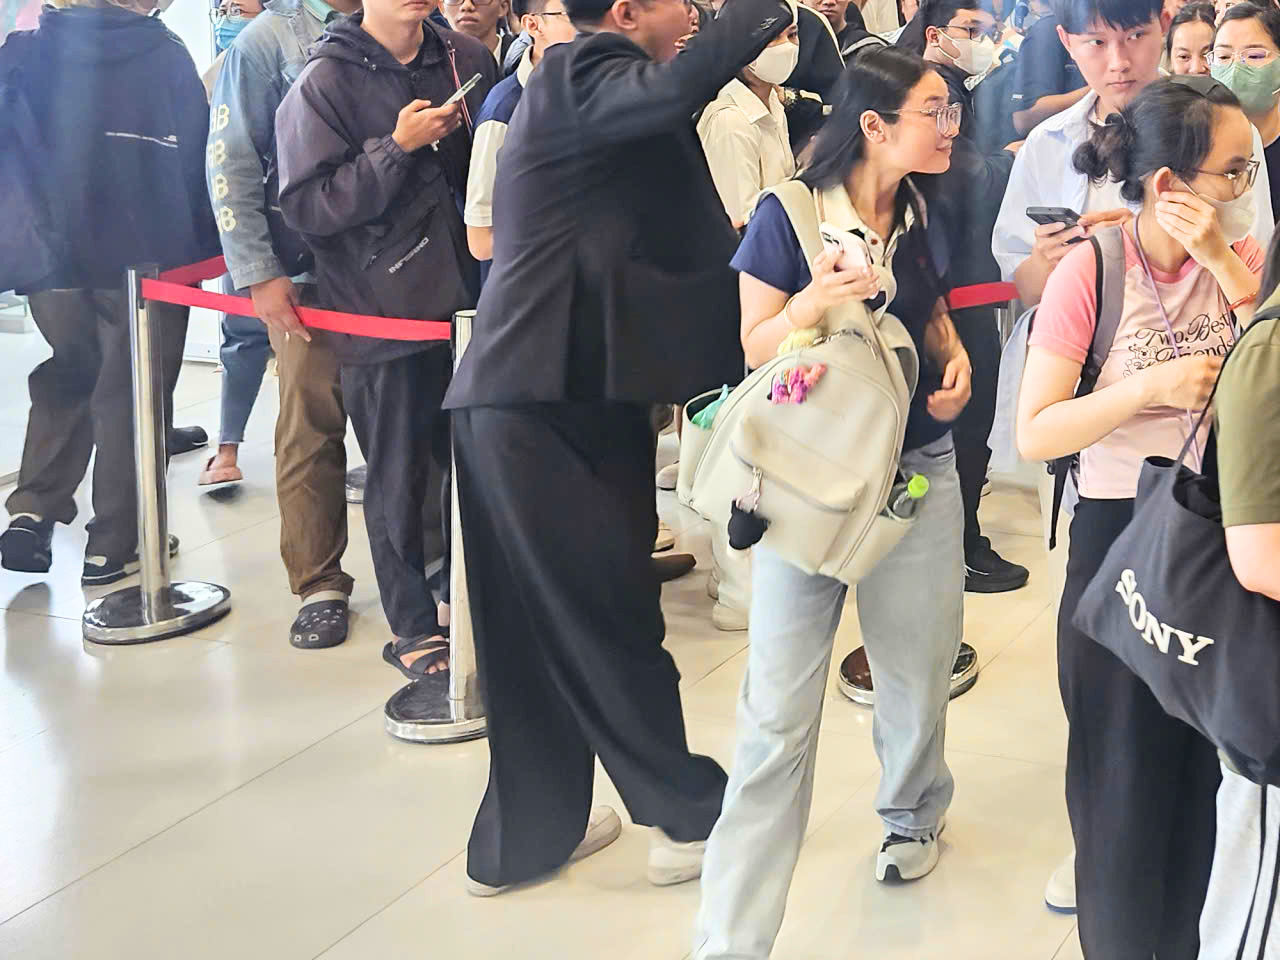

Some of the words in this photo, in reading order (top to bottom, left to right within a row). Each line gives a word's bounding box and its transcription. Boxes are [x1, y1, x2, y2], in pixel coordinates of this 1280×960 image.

[1134, 327, 1185, 346] Two
[1185, 312, 1230, 343] Best
[1115, 568, 1215, 666] SONY
